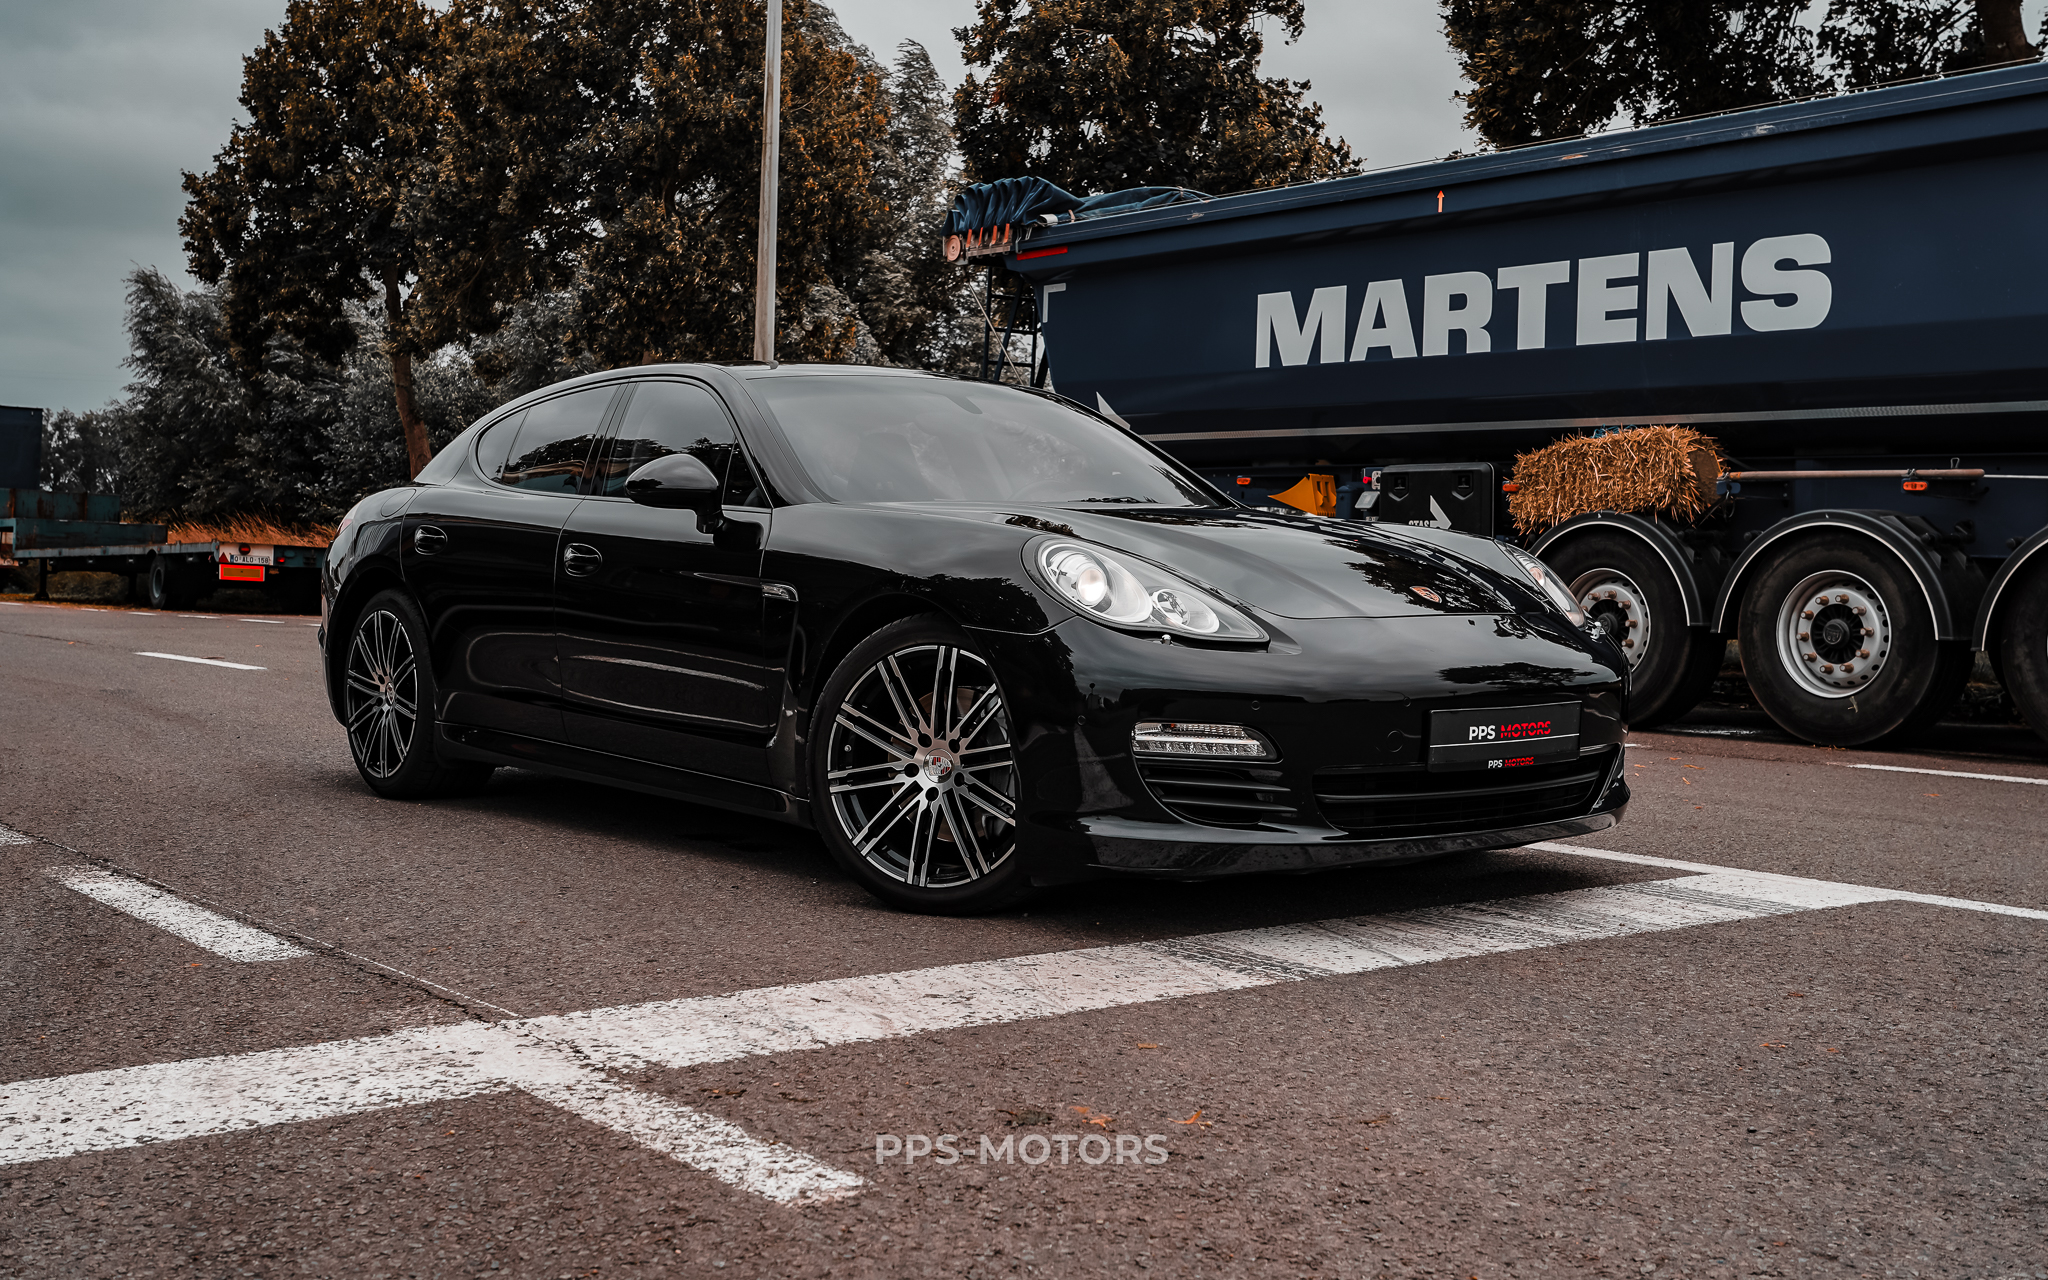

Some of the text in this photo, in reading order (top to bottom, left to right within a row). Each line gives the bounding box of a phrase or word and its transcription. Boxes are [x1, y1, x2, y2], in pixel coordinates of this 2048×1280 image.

[1255, 232, 1833, 368] MARTENS
[1469, 721, 1551, 740] PPS MOTORS
[1488, 757, 1534, 769] PPS MOTORS
